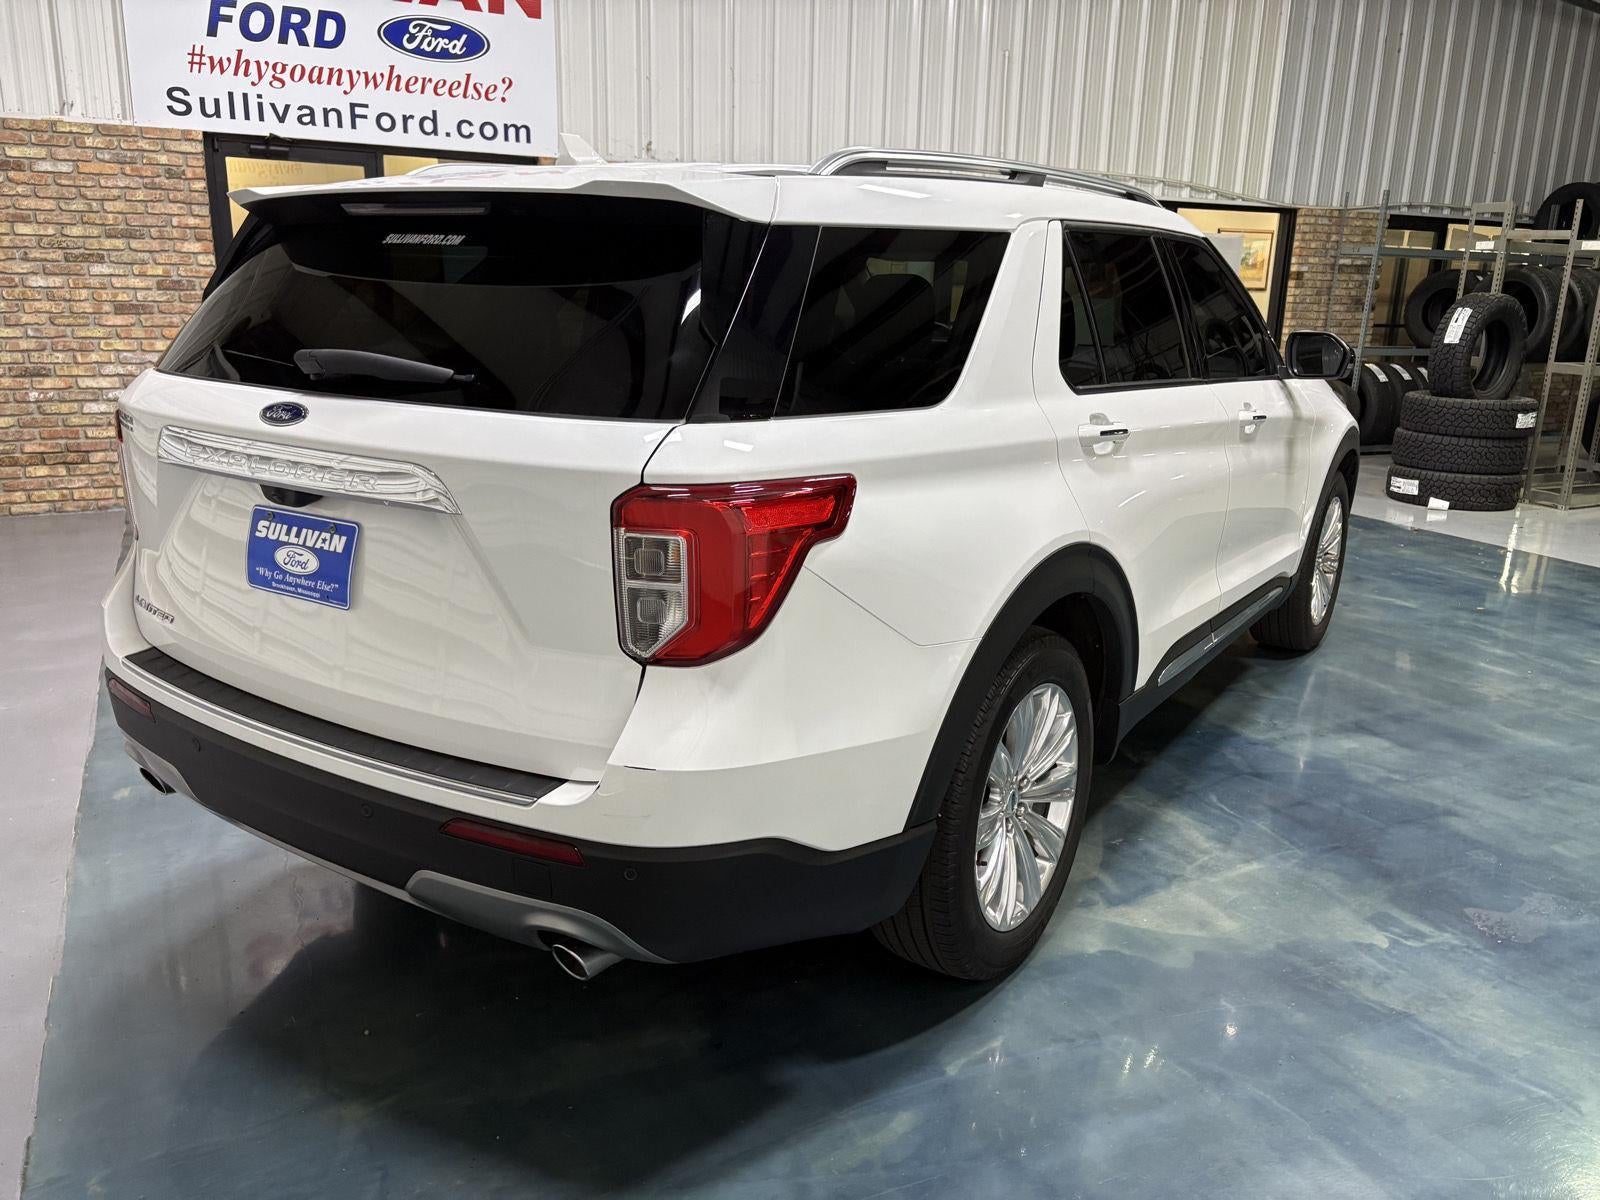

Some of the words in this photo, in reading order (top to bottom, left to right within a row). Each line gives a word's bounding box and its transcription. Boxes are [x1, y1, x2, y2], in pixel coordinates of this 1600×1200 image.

[206, 0, 346, 50] FORD
[402, 19, 468, 57] Ford
[187, 44, 513, 103] #whygoanywhereelse?
[165, 85, 533, 145] SullivanFord.com
[184, 442, 378, 491] EXPLORER
[255, 520, 347, 553] SULLIVAN
[273, 570, 283, 580] Go
[284, 573, 316, 588] Anywhere
[282, 550, 310, 571] Ford
